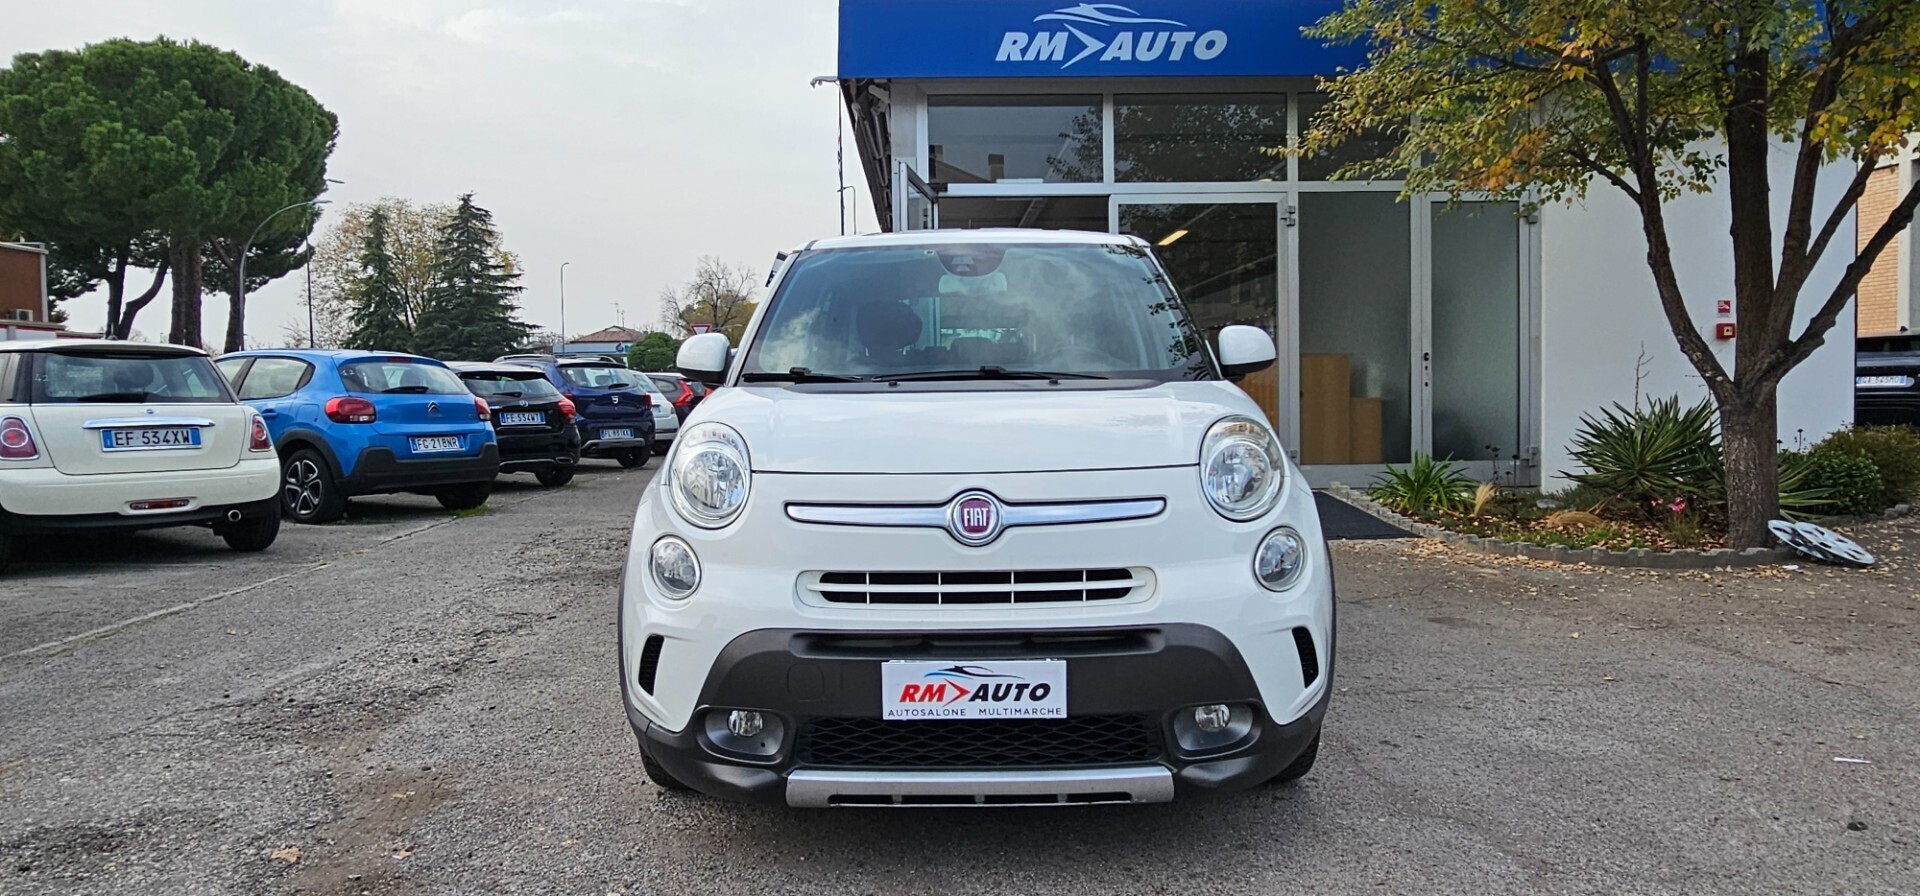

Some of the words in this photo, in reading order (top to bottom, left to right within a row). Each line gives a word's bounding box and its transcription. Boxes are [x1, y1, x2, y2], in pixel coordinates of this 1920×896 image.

[995, 31, 1069, 61] RM
[1100, 29, 1228, 62] AUTO
[114, 431, 134, 446] EF
[141, 430, 191, 446] 534XW
[963, 507, 989, 527] FIAT
[899, 684, 947, 703] RM
[968, 682, 1051, 702] AUTO
[888, 709, 966, 717] AUTOSALONE
[979, 707, 1062, 716] MULTIMARCHE
